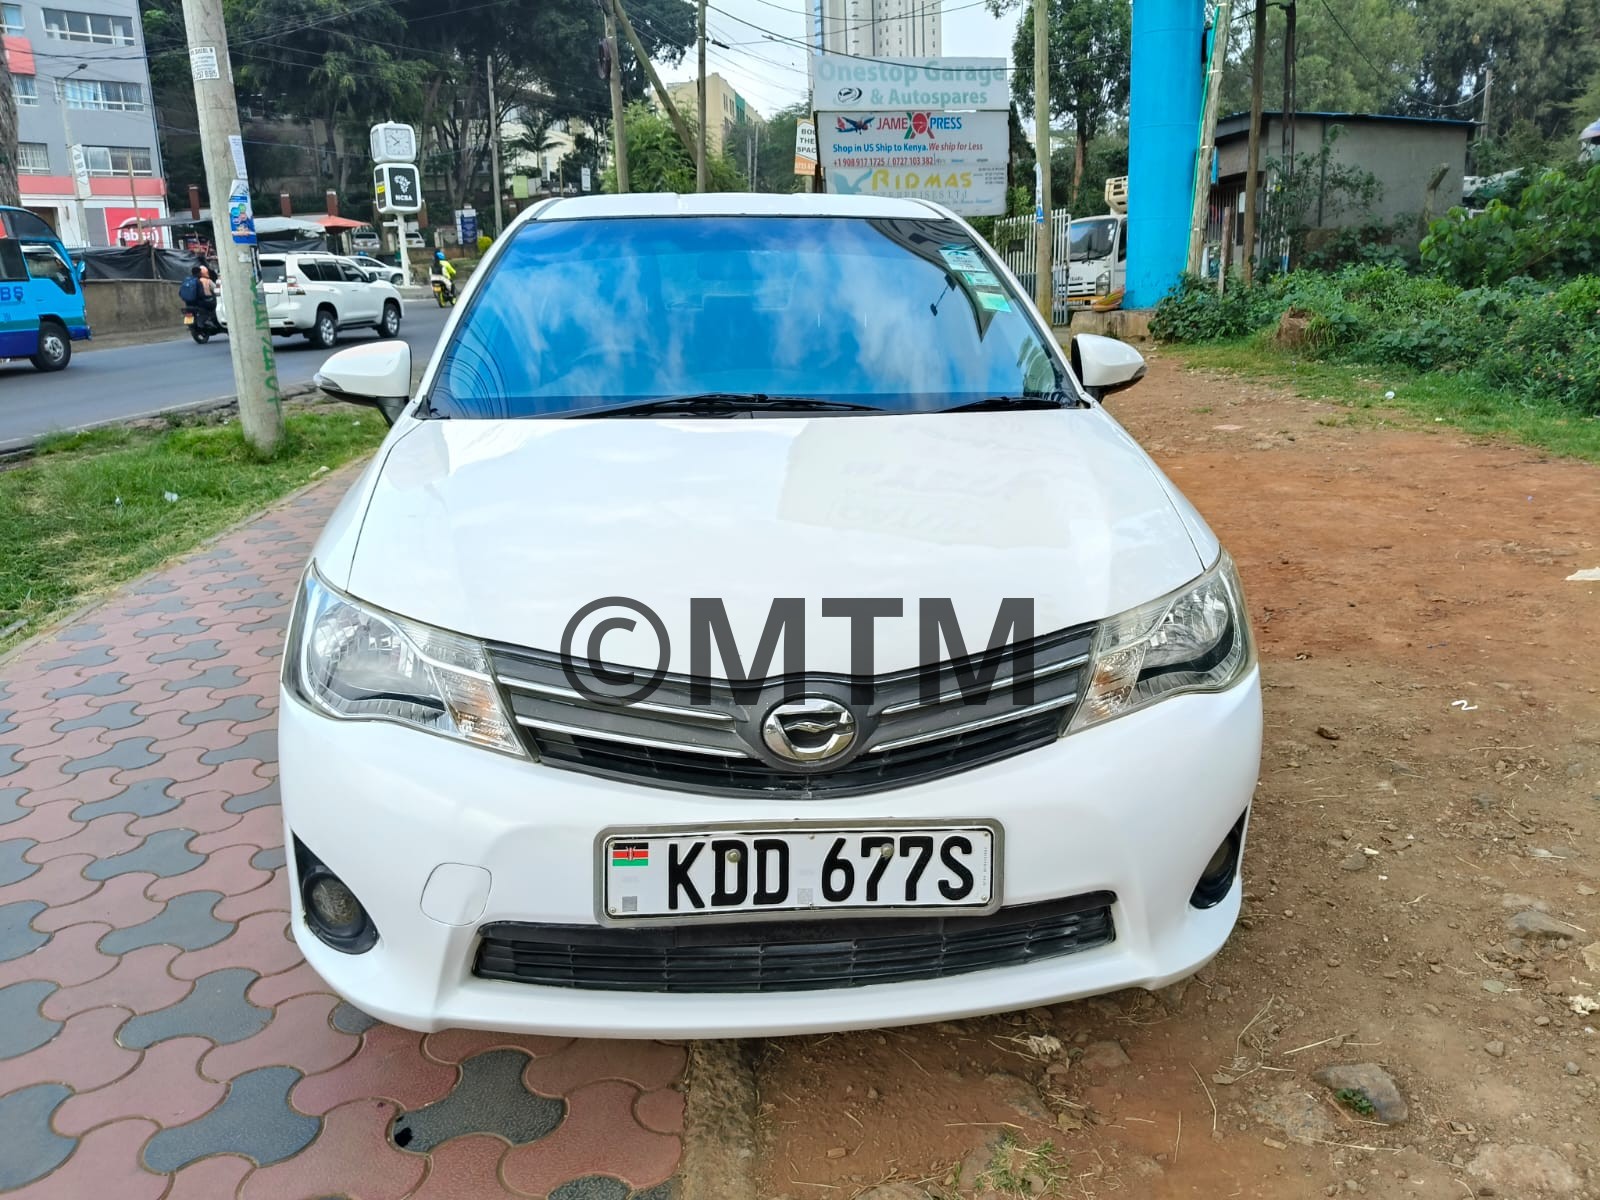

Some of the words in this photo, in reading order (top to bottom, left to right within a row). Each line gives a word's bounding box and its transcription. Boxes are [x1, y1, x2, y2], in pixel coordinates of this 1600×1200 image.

[818, 60, 918, 86] Onestop
[924, 60, 1005, 87] Garage
[870, 90, 883, 105] &
[888, 89, 987, 107] Autospares
[833, 144, 853, 153] Shop
[854, 143, 862, 152] in
[864, 143, 874, 152] US
[875, 143, 892, 153] Ship
[894, 143, 902, 152] to
[903, 142, 929, 153] Kenya.
[929, 142, 940, 151] We
[941, 142, 955, 152] ship
[956, 142, 967, 152] for
[968, 142, 983, 151] Less
[870, 158, 885, 167] 1725
[892, 157, 907, 166] 0727
[910, 157, 920, 166] 103
[923, 156, 933, 166] 382
[872, 168, 972, 191] RIDMAS
[668, 838, 790, 910] KDD
[821, 834, 975, 902] 677S
